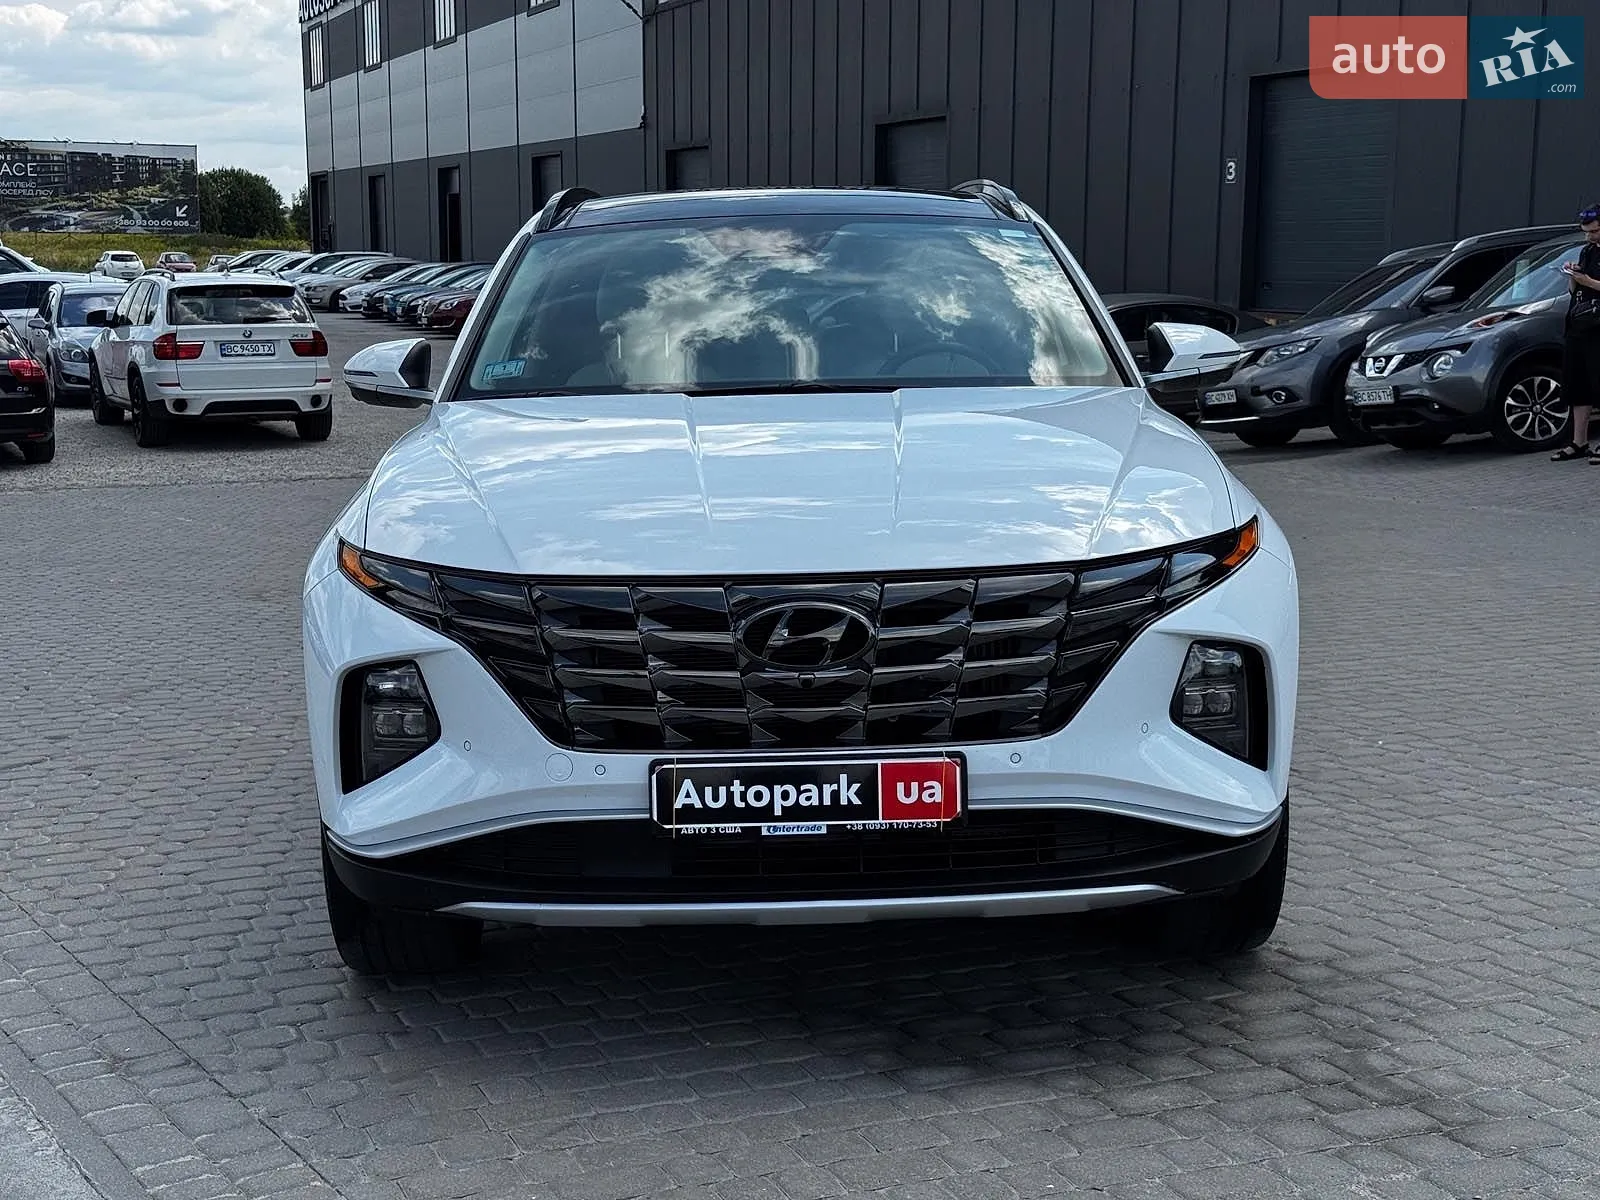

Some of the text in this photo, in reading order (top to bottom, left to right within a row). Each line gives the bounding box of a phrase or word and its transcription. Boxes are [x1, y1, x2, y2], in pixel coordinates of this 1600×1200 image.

[0, 162, 37, 176] ACE
[1227, 161, 1236, 180] 3
[674, 773, 943, 816] Autopark ua
[718, 825, 742, 834] США
